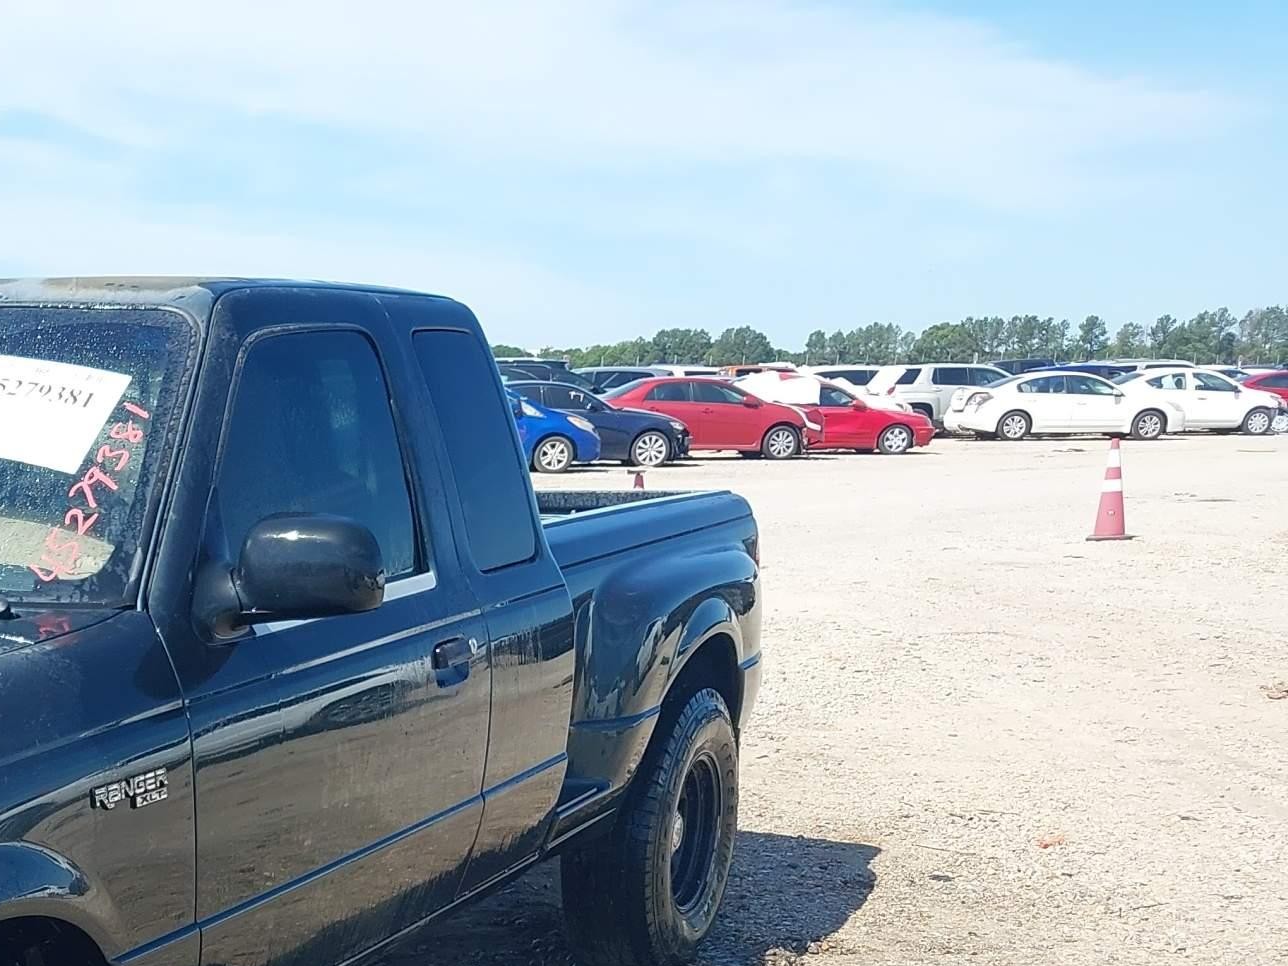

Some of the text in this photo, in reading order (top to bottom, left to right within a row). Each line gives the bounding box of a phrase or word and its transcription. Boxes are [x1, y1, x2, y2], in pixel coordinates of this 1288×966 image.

[29, 401, 150, 582] 45279381
[93, 767, 169, 810] RANGER
[138, 787, 167, 807] XLT
